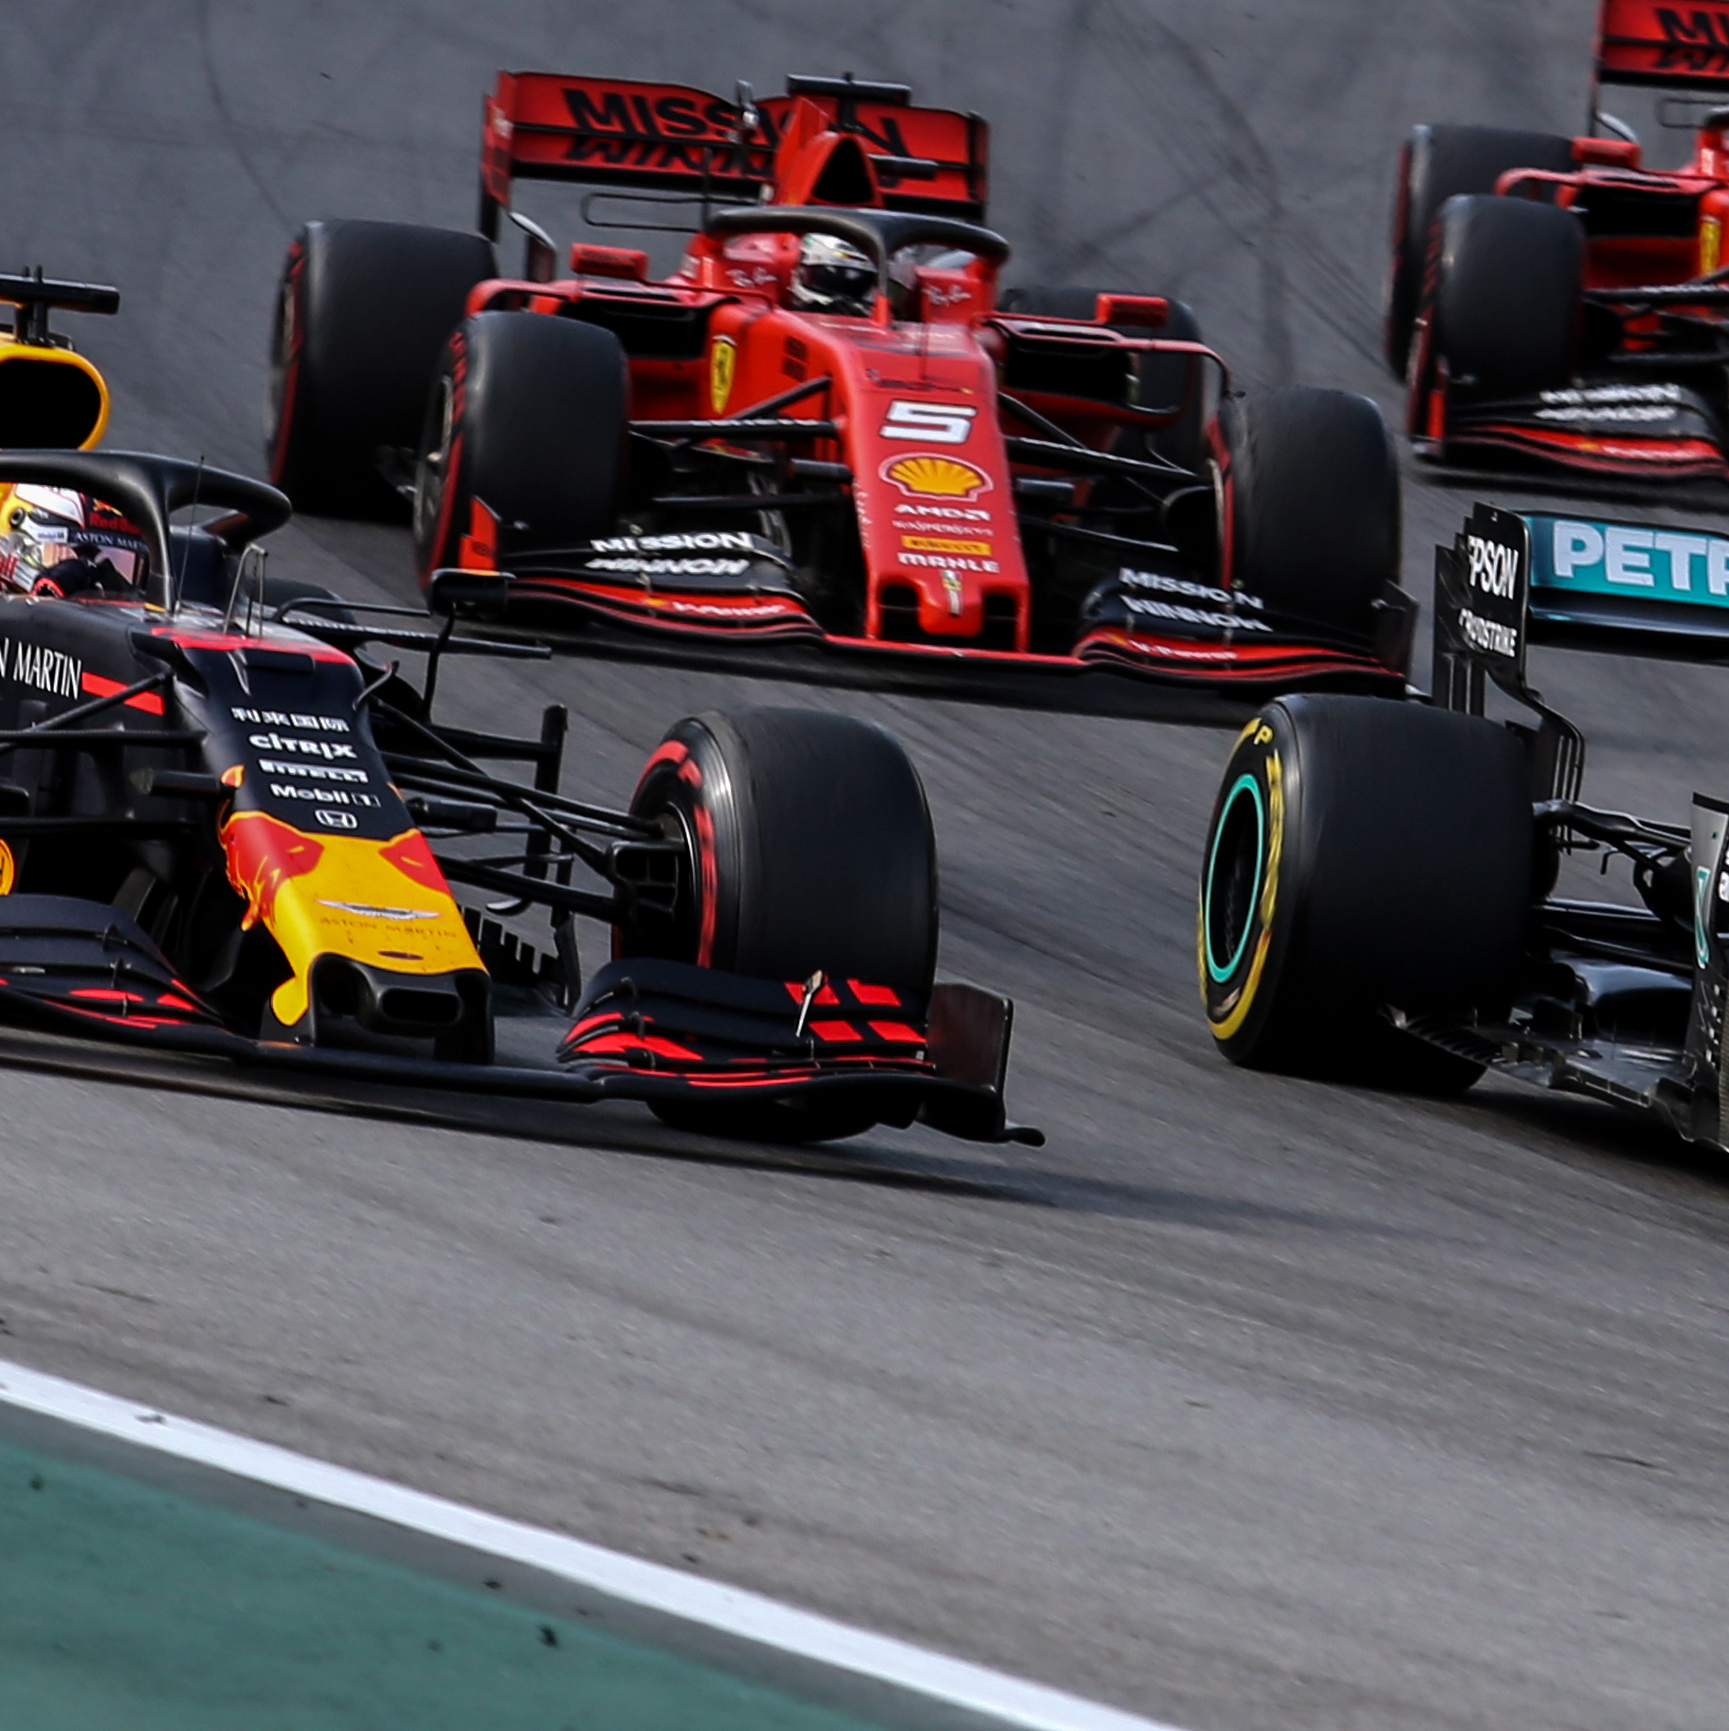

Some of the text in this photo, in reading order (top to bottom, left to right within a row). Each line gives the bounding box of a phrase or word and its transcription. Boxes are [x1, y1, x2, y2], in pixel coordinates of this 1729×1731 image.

[879, 398, 978, 445] 5
[590, 531, 755, 553] MISSION
[1118, 567, 1265, 610] MISSION
[12, 640, 83, 700] MARTIN
[270, 783, 351, 805] Mobil
